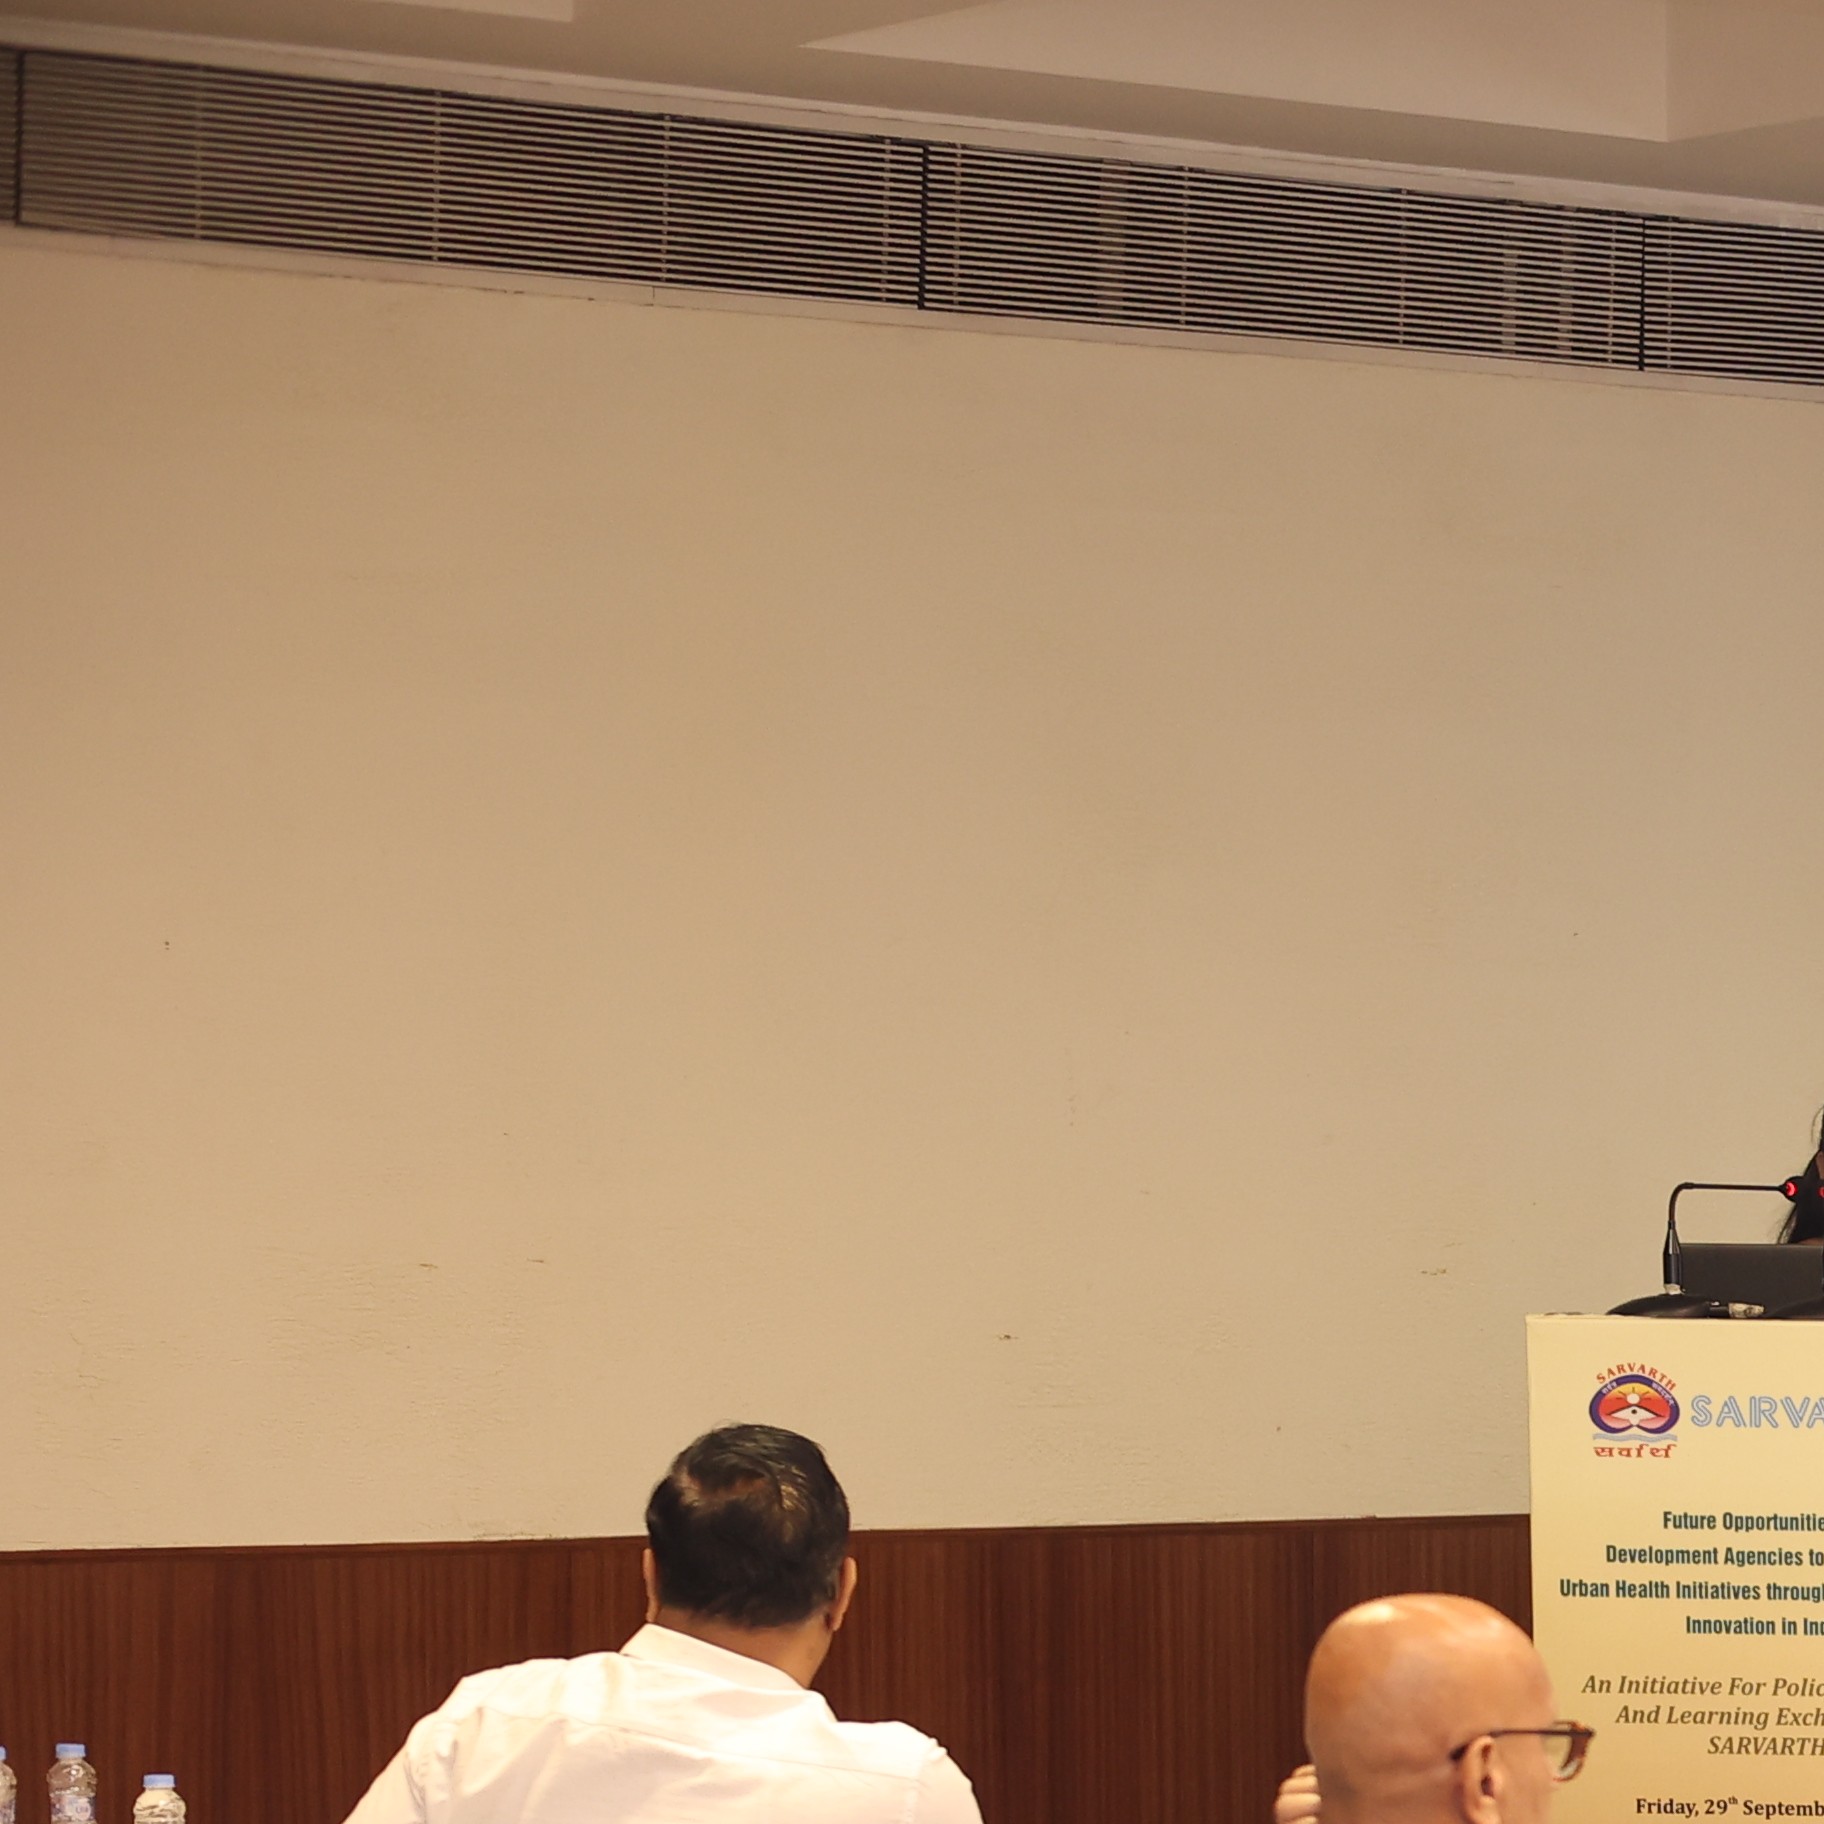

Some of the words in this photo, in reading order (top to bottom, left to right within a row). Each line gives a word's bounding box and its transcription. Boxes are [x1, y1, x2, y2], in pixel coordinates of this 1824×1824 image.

[1596, 1362, 1676, 1391] SARVARTH
[1664, 1511, 1716, 1530] Future
[1606, 1545, 1718, 1566] Development
[1724, 1547, 1803, 1567] Agencies
[1809, 1549, 1824, 1566] to
[1560, 1579, 1609, 1597] Urban
[1616, 1580, 1670, 1598] Health
[1676, 1581, 1760, 1600] Initiatives
[1686, 1616, 1775, 1635] Innovation
[1782, 1617, 1797, 1635] in
[1582, 1675, 1611, 1693] An
[1618, 1676, 1722, 1695] Initiative
[1729, 1678, 1766, 1695] For
[1615, 1705, 1661, 1723] And
[1667, 1706, 1769, 1730] Learning
[1637, 1798, 1699, 1818] Friday,
[1705, 1797, 1738, 1815] 29th
